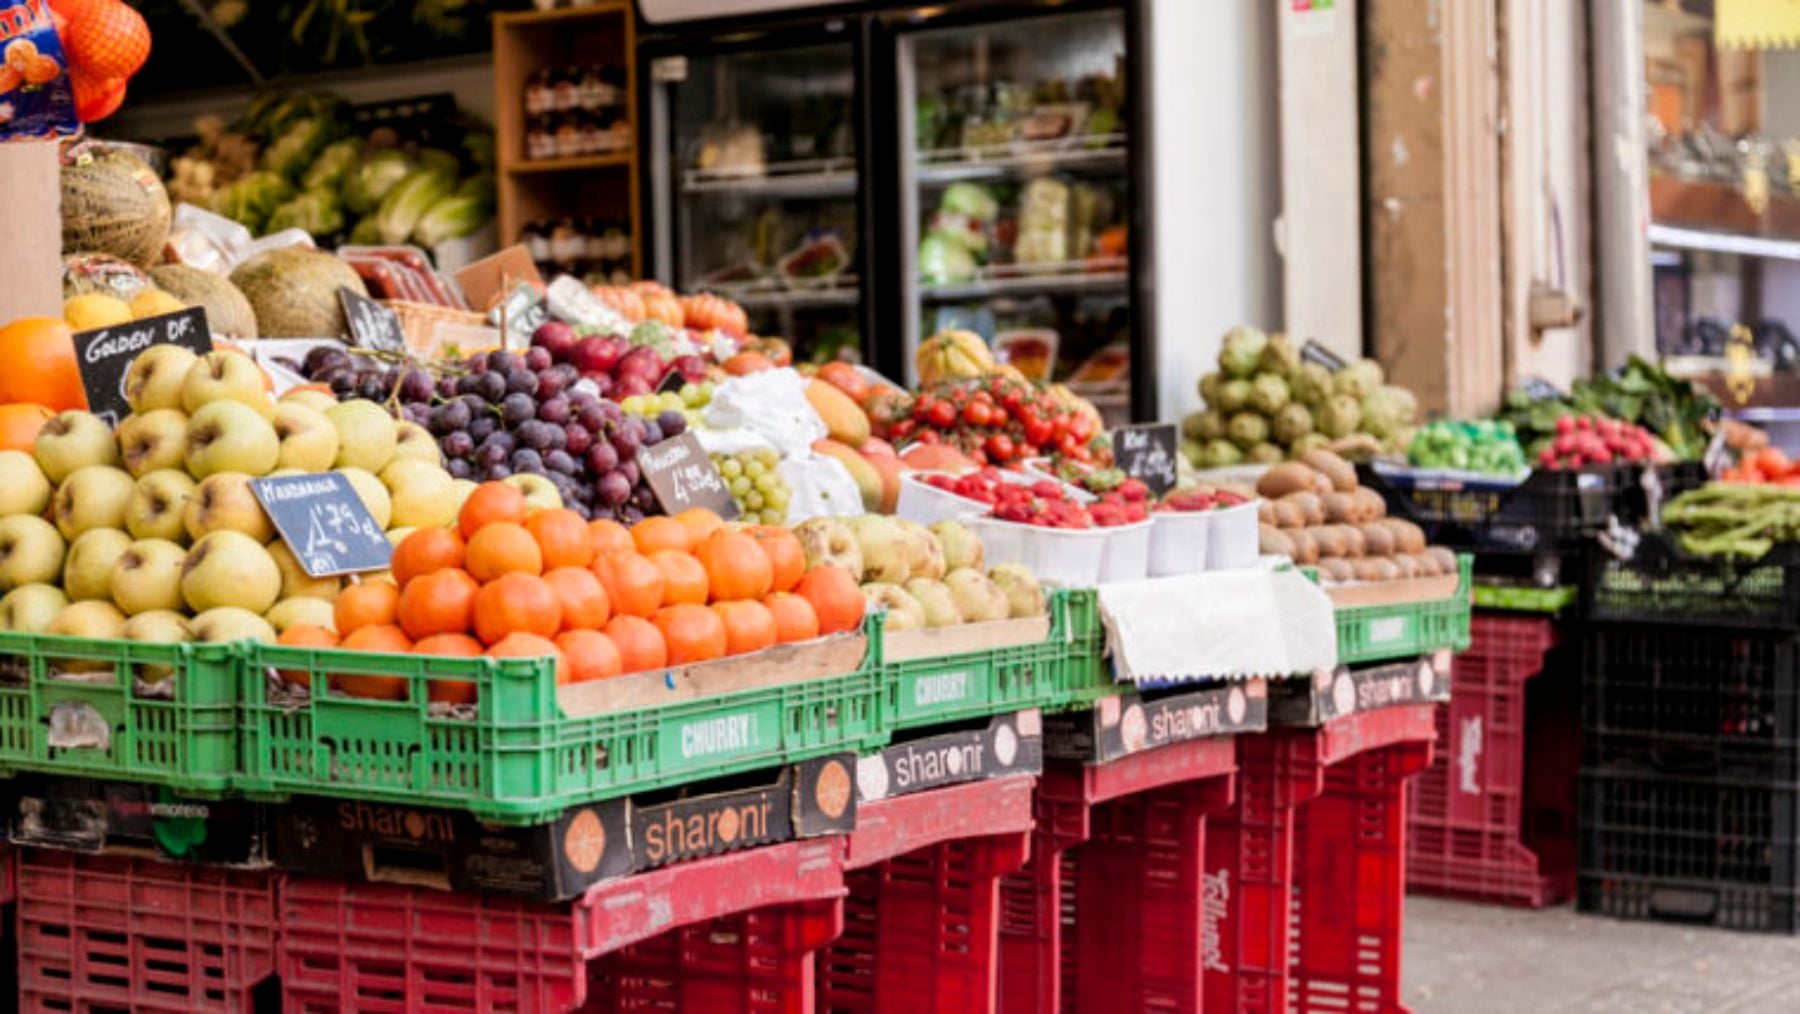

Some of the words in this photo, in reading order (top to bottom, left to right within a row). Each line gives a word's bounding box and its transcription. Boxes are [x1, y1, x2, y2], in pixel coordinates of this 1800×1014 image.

[681, 712, 750, 759] CHURRY
[1152, 695, 1222, 741] sharoni
[894, 733, 984, 787] sharoni
[337, 799, 455, 842] sharoni
[645, 792, 768, 861] sharoni
